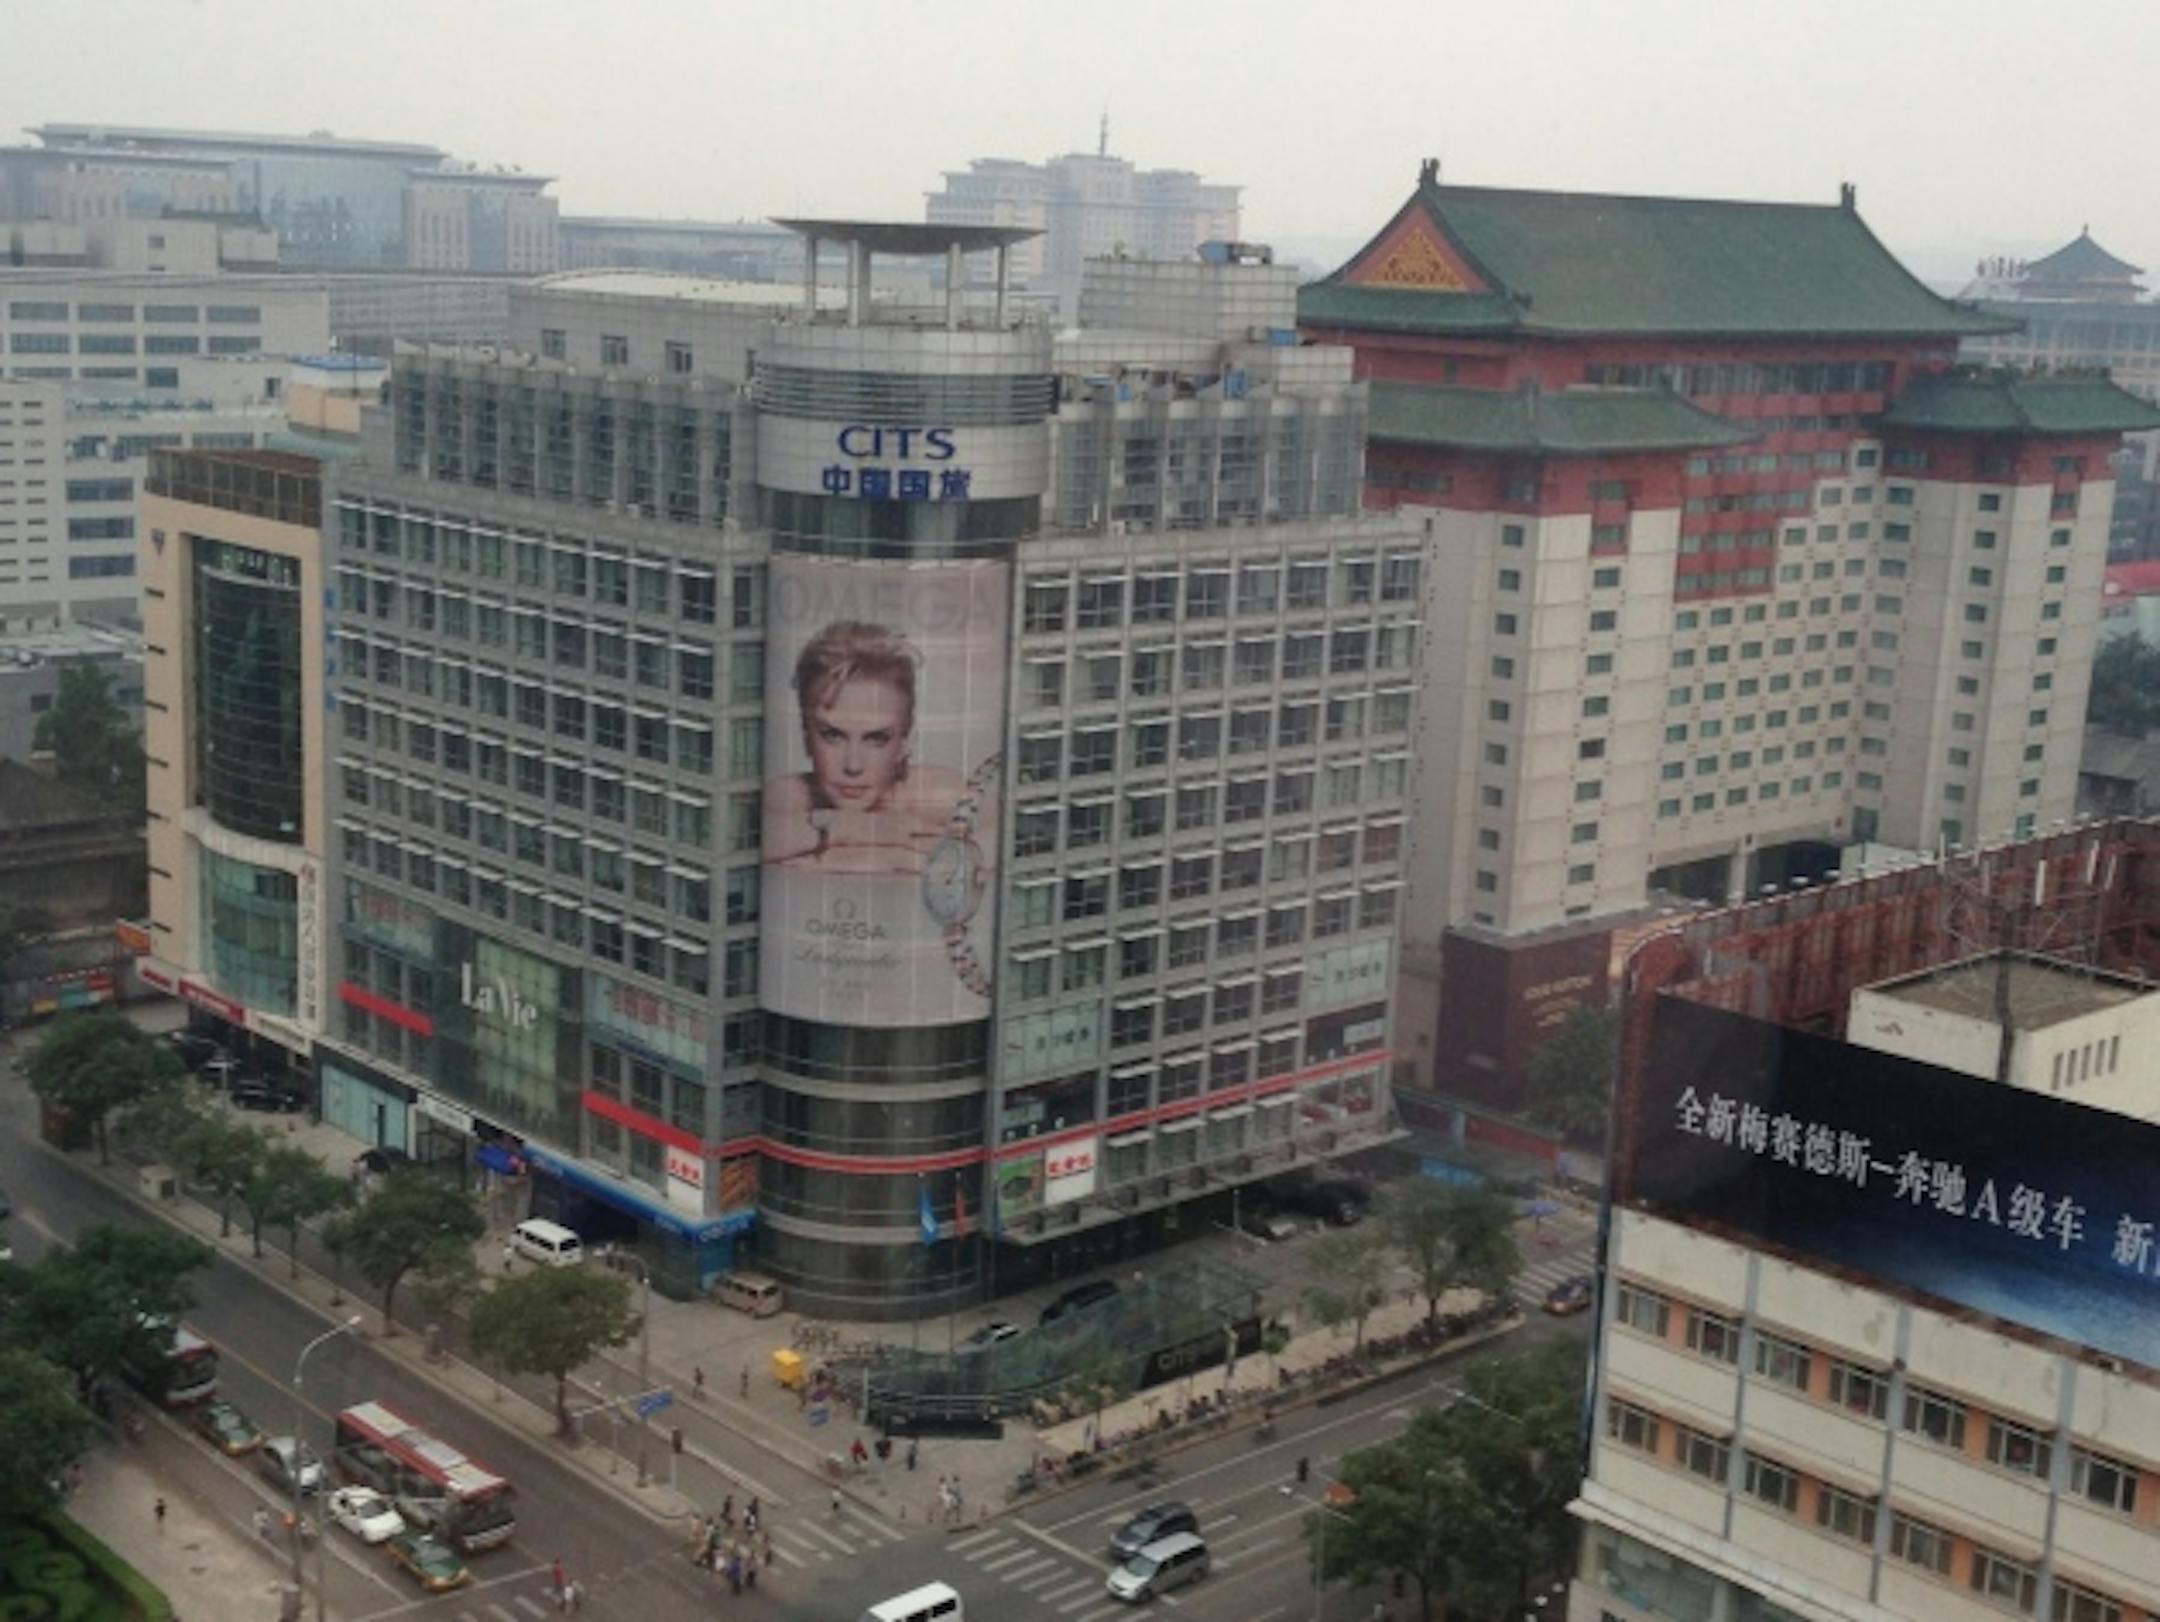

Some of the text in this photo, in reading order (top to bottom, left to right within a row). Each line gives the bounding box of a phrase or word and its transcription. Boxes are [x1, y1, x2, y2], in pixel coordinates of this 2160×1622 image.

[838, 425, 956, 460] CITS
[806, 918, 886, 940] OMEGA
[2111, 1213, 2160, 1277] 新
